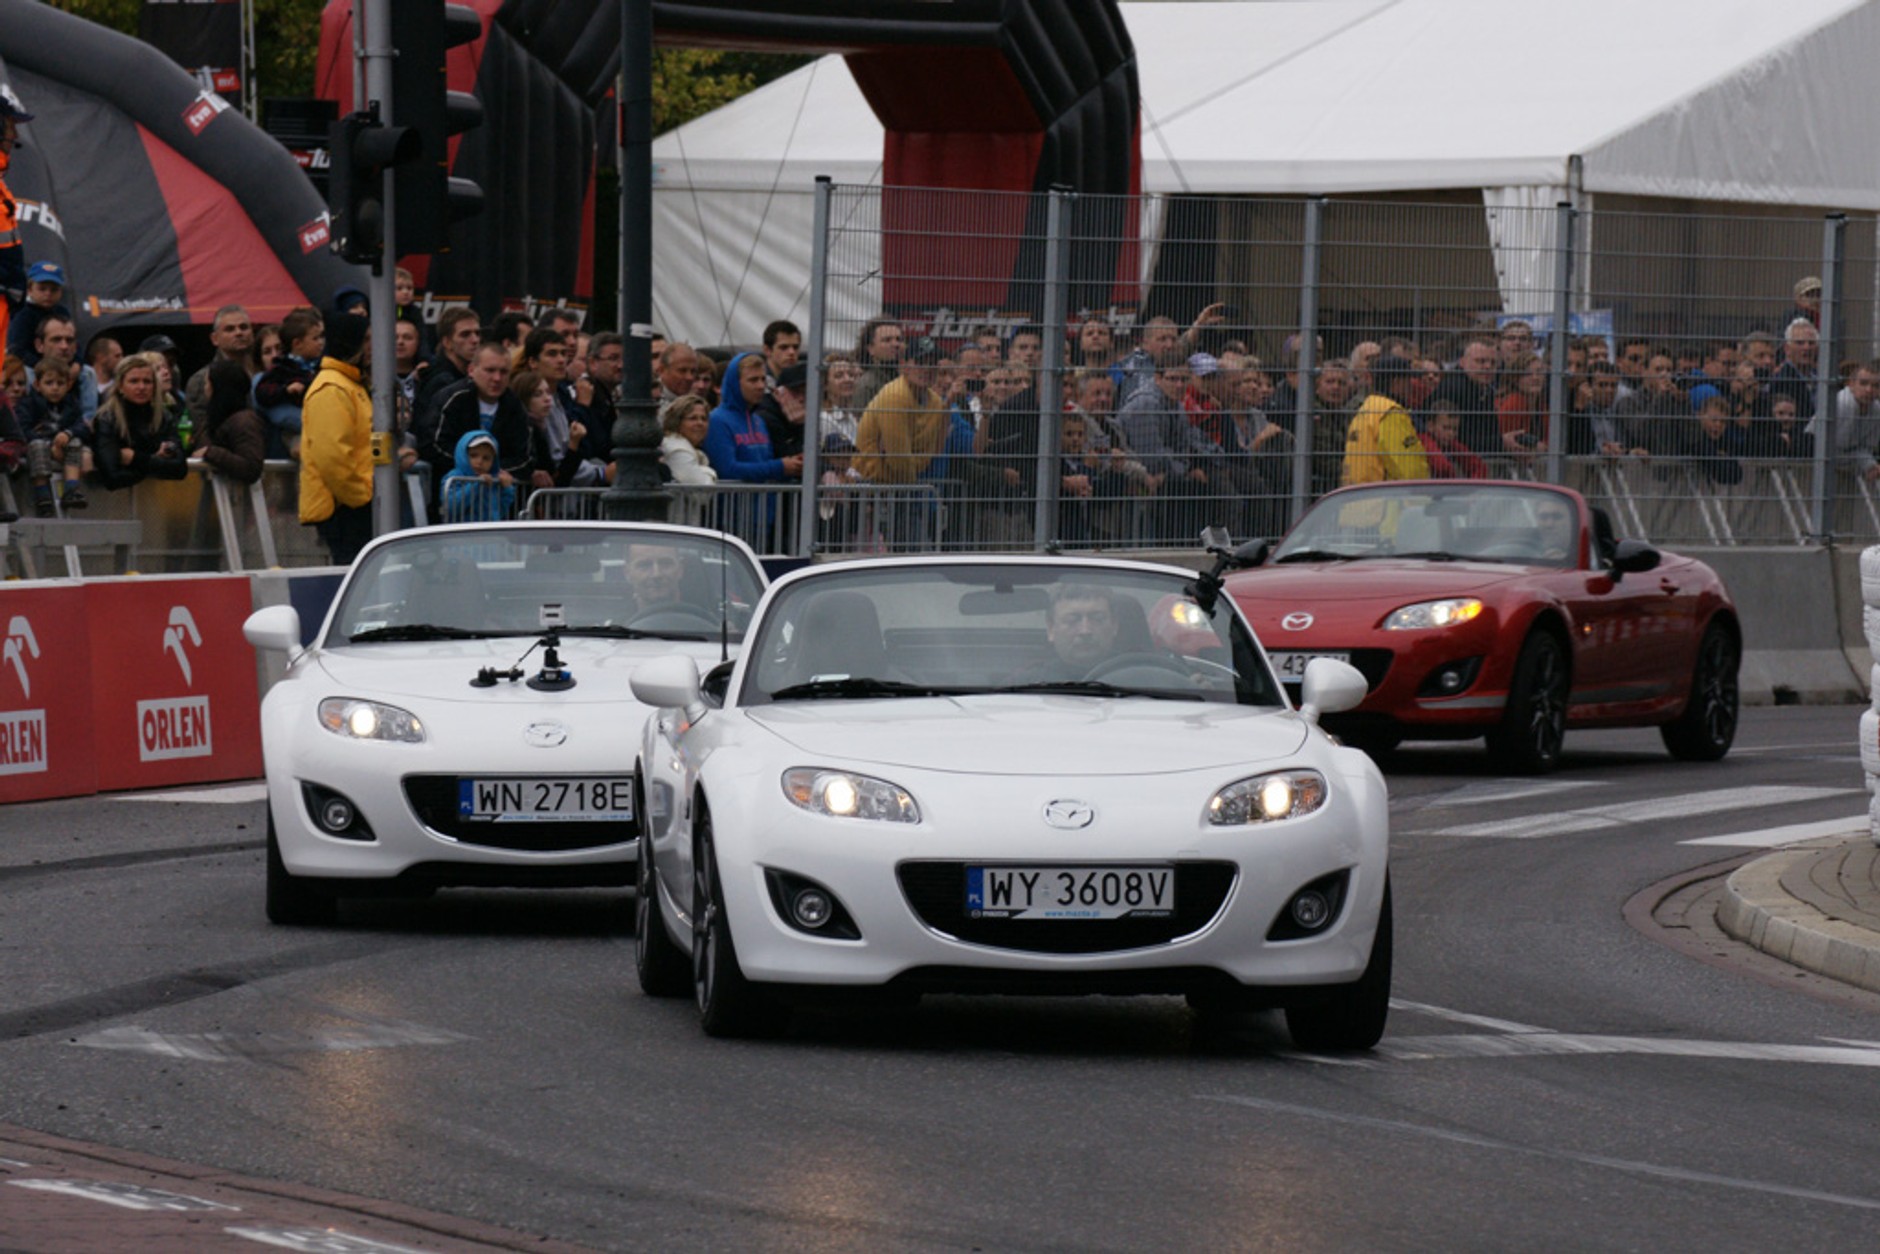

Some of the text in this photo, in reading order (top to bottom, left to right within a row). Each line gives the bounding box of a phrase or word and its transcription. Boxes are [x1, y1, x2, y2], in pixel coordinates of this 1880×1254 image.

[189, 105, 212, 128] tvn
[303, 226, 328, 247] tvn
[0, 719, 42, 764] RLEN
[142, 705, 207, 752] ORLEN
[478, 782, 628, 812] WN 2718E
[969, 894, 981, 903] PL
[990, 872, 1168, 907] WY 3608V
